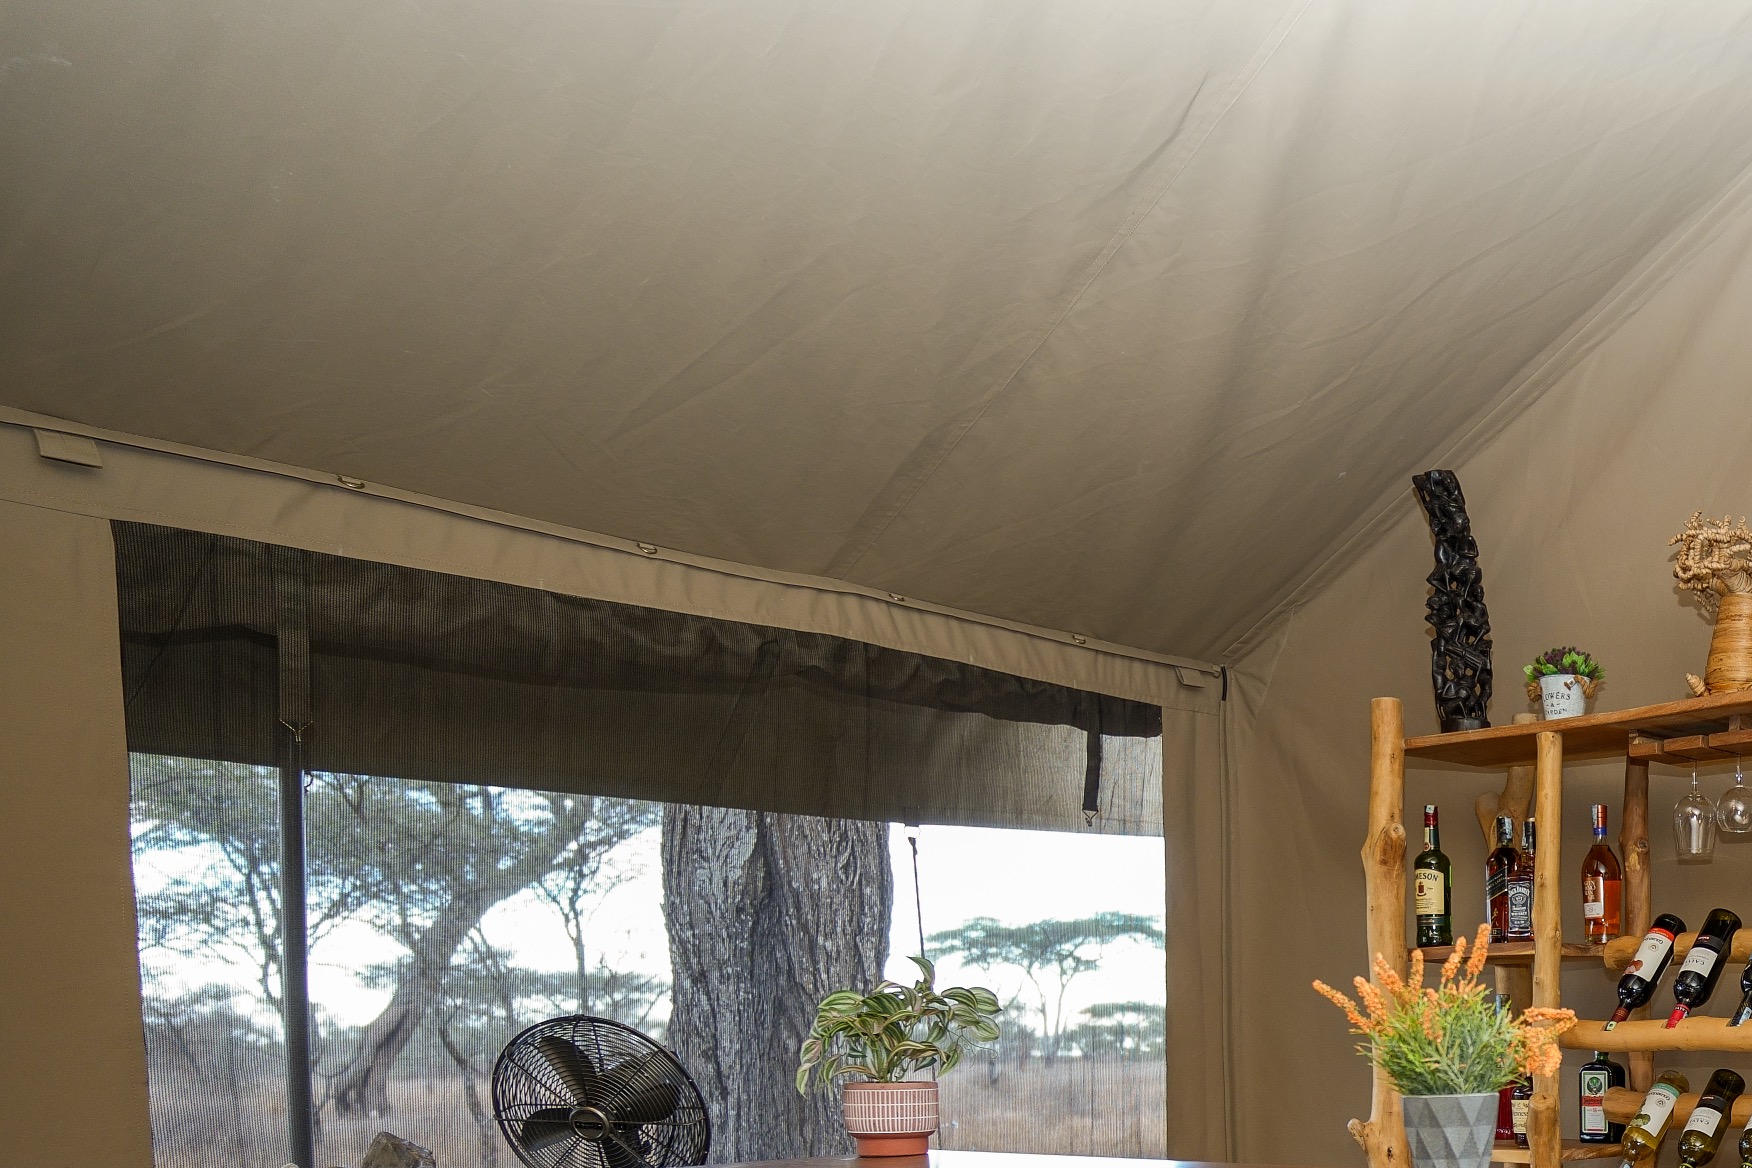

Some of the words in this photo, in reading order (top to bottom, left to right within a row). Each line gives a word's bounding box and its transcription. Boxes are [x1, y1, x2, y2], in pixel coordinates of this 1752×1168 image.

[1543, 691, 1571, 702] OWERS
[1546, 708, 1568, 716] RDEN
[1416, 872, 1439, 882] MESON
